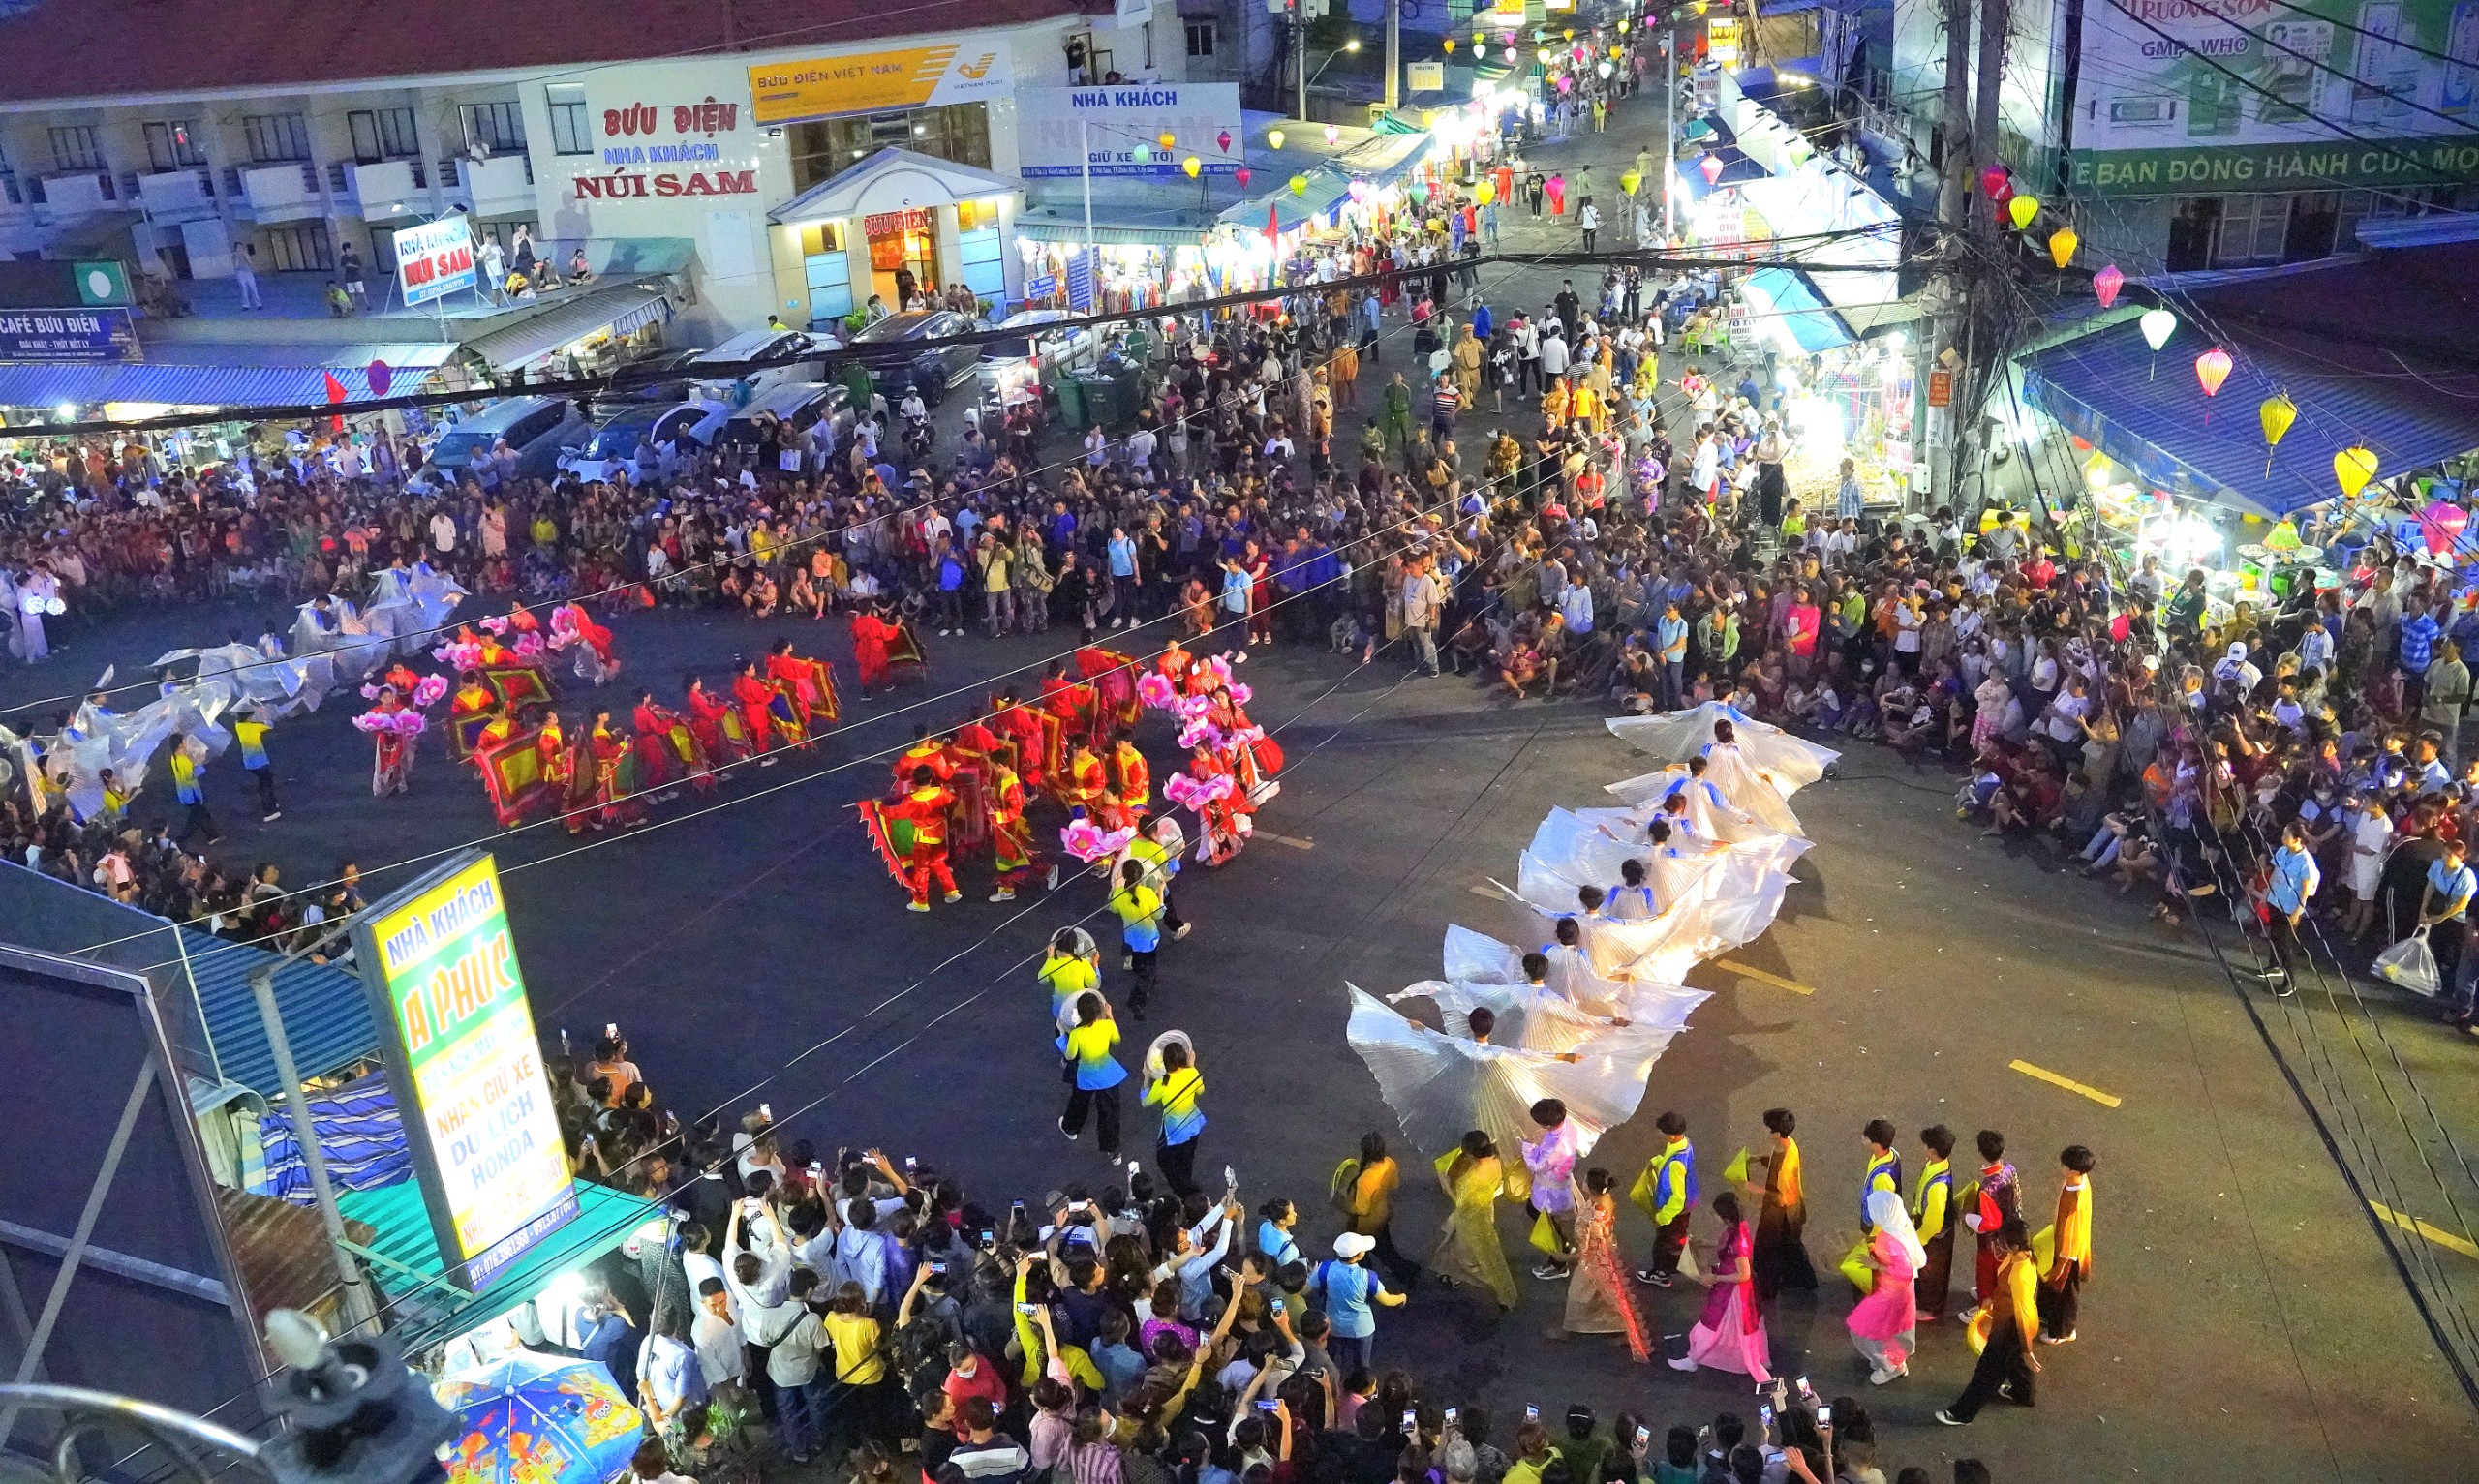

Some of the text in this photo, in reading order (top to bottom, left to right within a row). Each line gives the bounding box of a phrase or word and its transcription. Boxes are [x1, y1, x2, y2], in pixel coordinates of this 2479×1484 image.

[2140, 40, 2187, 58] GMP
[2201, 36, 2250, 56] WHO
[872, 63, 903, 75] NAM
[1072, 87, 1178, 107] NHÀ KHÁCH
[604, 102, 658, 136] BƯU
[674, 96, 737, 138] ĐIỆN
[649, 140, 719, 164] KHÁCH
[1116, 152, 1133, 162] XE
[572, 167, 759, 199] NÚI SAM
[2096, 161, 2158, 188] BẠN
[2265, 150, 2349, 178] HÀNH
[404, 246, 473, 287] NÚI SAM
[0, 313, 102, 336] CAFÉ BƯU ĐIỆN
[386, 880, 495, 967] NHÀ KHÁCH
[405, 932, 513, 1051] A PHÚC
[511, 1053, 534, 1086] XE
[450, 1090, 535, 1166] DU LỊCH
[471, 1129, 536, 1191] HONDA
